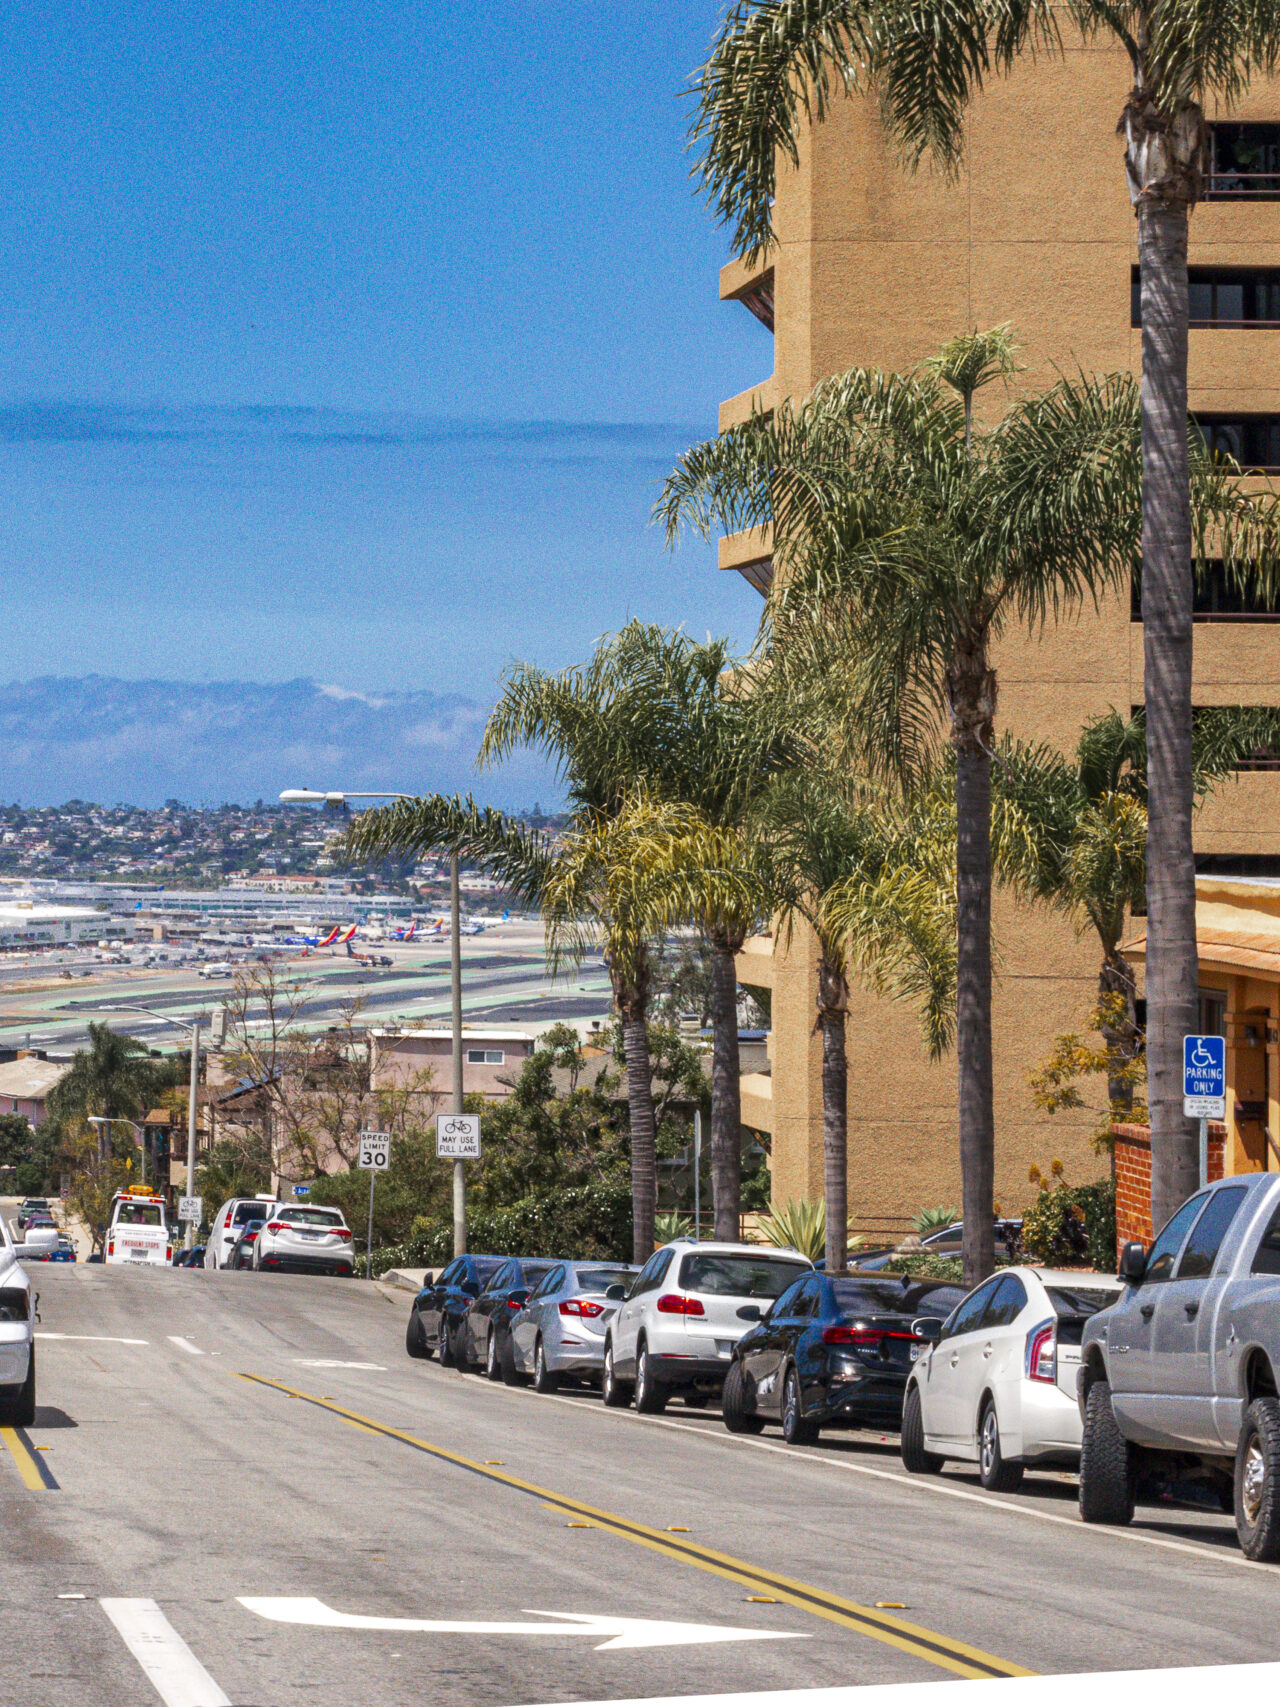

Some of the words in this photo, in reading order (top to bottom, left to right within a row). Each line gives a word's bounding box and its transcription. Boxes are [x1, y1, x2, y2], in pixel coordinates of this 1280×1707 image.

[1186, 1068, 1222, 1080] PARKING
[1193, 1081, 1215, 1093] ONLY
[362, 1134, 389, 1142] SPEED
[441, 1136, 456, 1144] MAY
[460, 1136, 475, 1144] USE
[439, 1145, 456, 1153] FULL
[459, 1145, 477, 1153] LANE
[362, 1152, 386, 1166] 30
[122, 1240, 144, 1248] FREQUENT
[145, 1241, 160, 1249] STOPS
